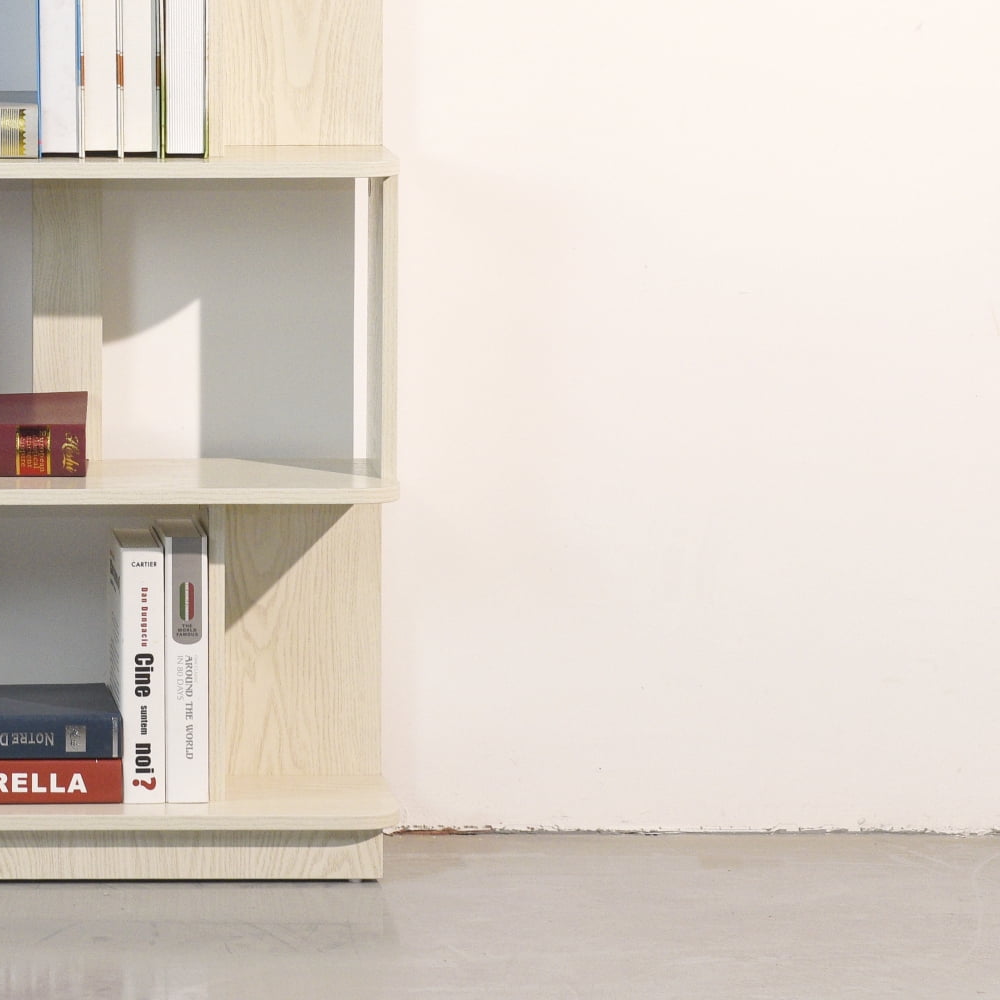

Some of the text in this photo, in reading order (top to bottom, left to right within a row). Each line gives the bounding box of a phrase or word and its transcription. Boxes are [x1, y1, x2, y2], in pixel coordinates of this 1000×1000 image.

[177, 655, 184, 665] IN
[134, 653, 154, 697] Cine
[177, 667, 184, 677] 80
[185, 655, 194, 760] AROUND THE WORLD
[140, 705, 148, 735] suntem
[12, 733, 55, 746] NOTRE
